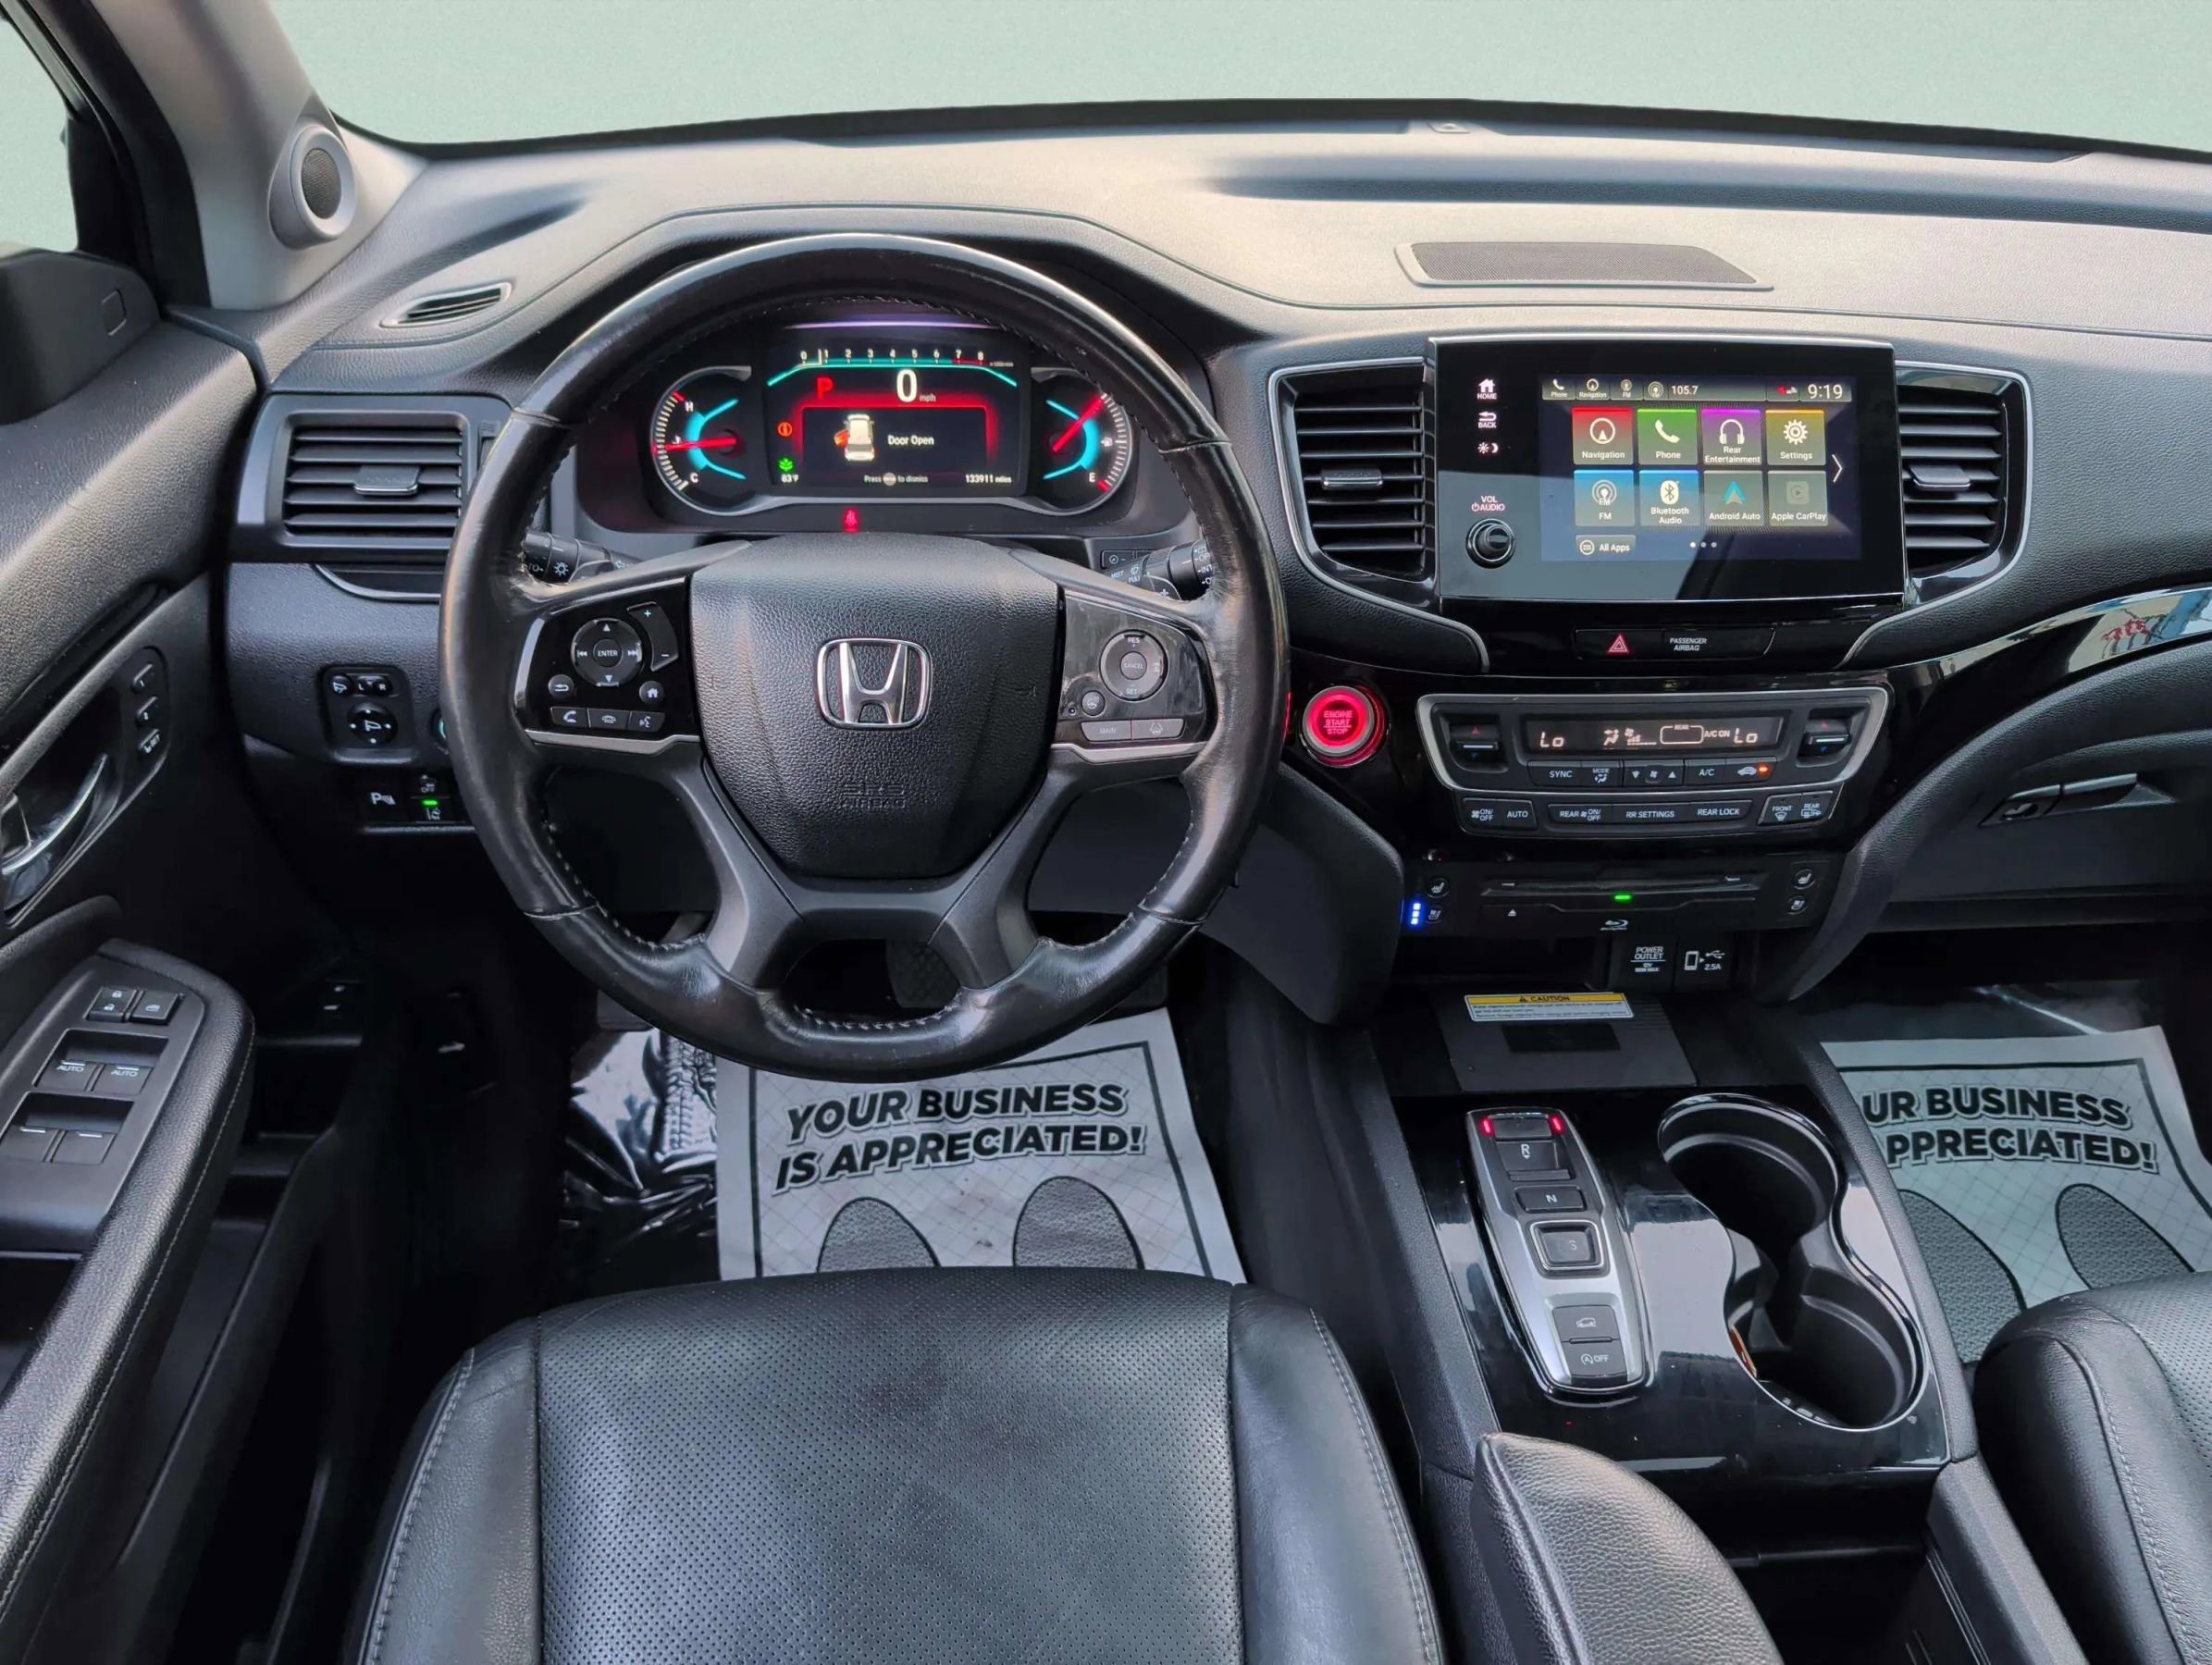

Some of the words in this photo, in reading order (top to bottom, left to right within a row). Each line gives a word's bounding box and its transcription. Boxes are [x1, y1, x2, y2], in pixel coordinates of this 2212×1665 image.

[817, 376, 834, 399] P
[896, 369, 918, 402] 0
[920, 393, 936, 403] mph
[1671, 385, 1699, 396] 105.7
[1578, 391, 1608, 400] Navigation
[1807, 383, 1844, 400] 9:19
[685, 401, 694, 413] H
[1477, 421, 1497, 429] BACK
[887, 435, 909, 446] Door
[910, 435, 934, 447] Open
[1723, 445, 1741, 454] Rear
[1581, 450, 1625, 461] Navigation
[1655, 450, 1682, 460] Phone
[1704, 454, 1762, 464] Entertainment
[1779, 450, 1814, 462] Settings
[690, 472, 698, 483] C
[965, 474, 994, 485] 133911
[995, 475, 1012, 484] miles
[1089, 473, 1096, 483] E
[1480, 495, 1499, 504] VOL
[1480, 503, 1505, 512] AUDIO
[1650, 506, 1689, 515] Bluetooth
[1599, 512, 1612, 520] FM
[1659, 516, 1682, 525] Audio
[1709, 512, 1740, 521] Android
[1742, 512, 1761, 521] Auto
[1771, 512, 1794, 523] Apple
[1795, 512, 1827, 522] CarPlay
[1599, 543, 1609, 552] All
[1611, 544, 1631, 554] Apps
[597, 649, 619, 658] ENTER
[1324, 709, 1353, 719] ENGINE
[1325, 719, 1351, 727] START
[1327, 727, 1349, 735] STOP
[1703, 730, 1718, 738] A/C
[1718, 730, 1731, 738] ON
[1733, 727, 1759, 744] Lo
[1539, 732, 1565, 748] Lo
[1548, 769, 1574, 779] SYNC
[1698, 768, 1716, 777] A/C
[1506, 810, 1528, 819] AUTO
[1559, 810, 1579, 819] REAR
[1625, 810, 1637, 819] RR
[1638, 809, 1675, 819] SETTINGS
[1697, 808, 1718, 817] REAR
[1719, 808, 1740, 816] LOCK
[1704, 963, 1722, 971] 2.5A
[56, 1065, 84, 1073] AUTO
[111, 1069, 138, 1078] AUTO
[1861, 1090, 1918, 1122] UR
[1926, 1086, 2132, 1128] BUSINESS
[788, 1088, 908, 1142] YOUR
[923, 1083, 1126, 1119] BUSINESS
[1520, 1143, 1531, 1156] R
[1885, 1127, 2158, 1173] PPRECIATED!
[776, 1151, 825, 1190] IS
[831, 1125, 1144, 1178] APPRECIATED!
[1545, 1194, 1557, 1203] N
[1593, 1354, 1610, 1363] OFF
